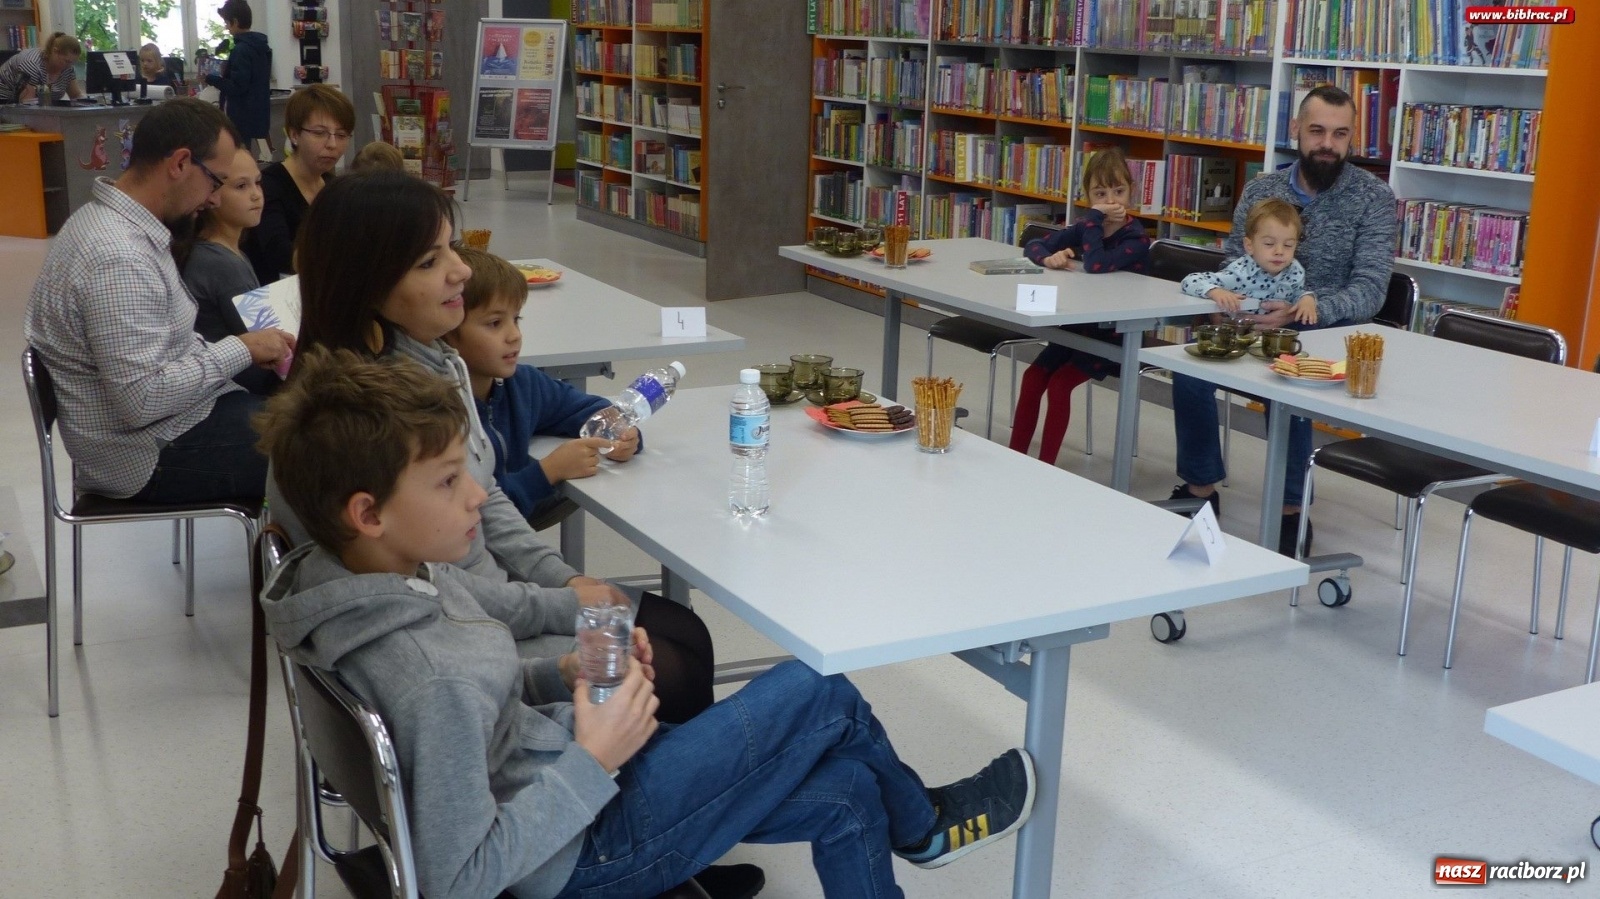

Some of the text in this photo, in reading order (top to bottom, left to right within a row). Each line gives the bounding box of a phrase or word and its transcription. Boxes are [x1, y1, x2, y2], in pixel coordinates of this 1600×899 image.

[957, 139, 965, 157] LAT
[1030, 289, 1036, 303] 1
[676, 310, 685, 331] 4
